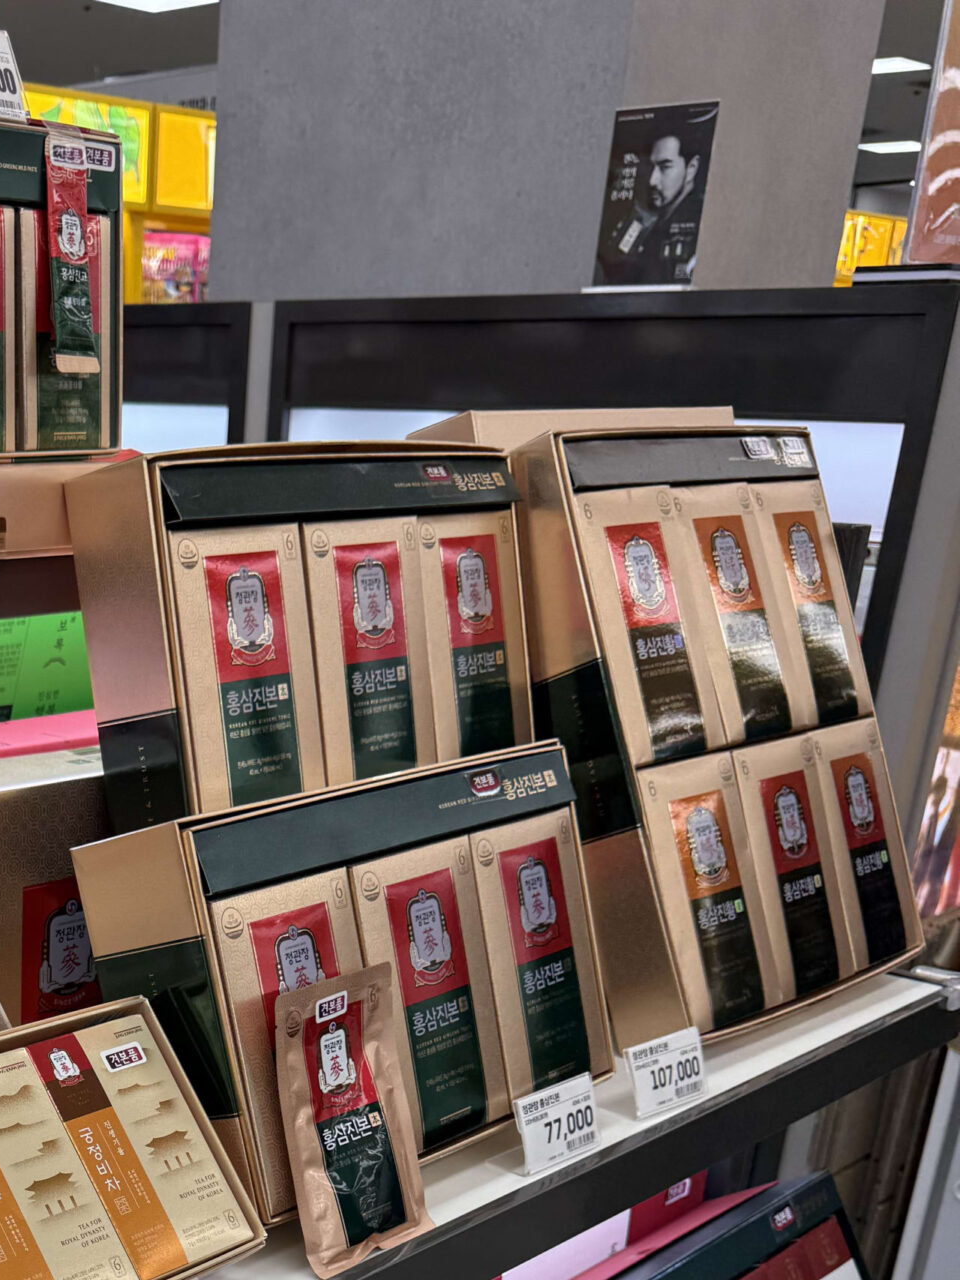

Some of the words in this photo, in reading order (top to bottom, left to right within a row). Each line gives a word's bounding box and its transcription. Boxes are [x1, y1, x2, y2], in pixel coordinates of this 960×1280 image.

[351, 668, 397, 698] 홍삼진본
[227, 685, 279, 717] 홍삼진본
[284, 947, 310, 963] 정관장
[411, 1004, 461, 1037] 홍삼진본
[108, 1048, 139, 1068] 견본품
[650, 1056, 700, 1091] 107,000
[322, 1116, 373, 1151] 홍삼진본
[544, 1105, 594, 1145] 77,000
[78, 1126, 121, 1193] 궁정비차
